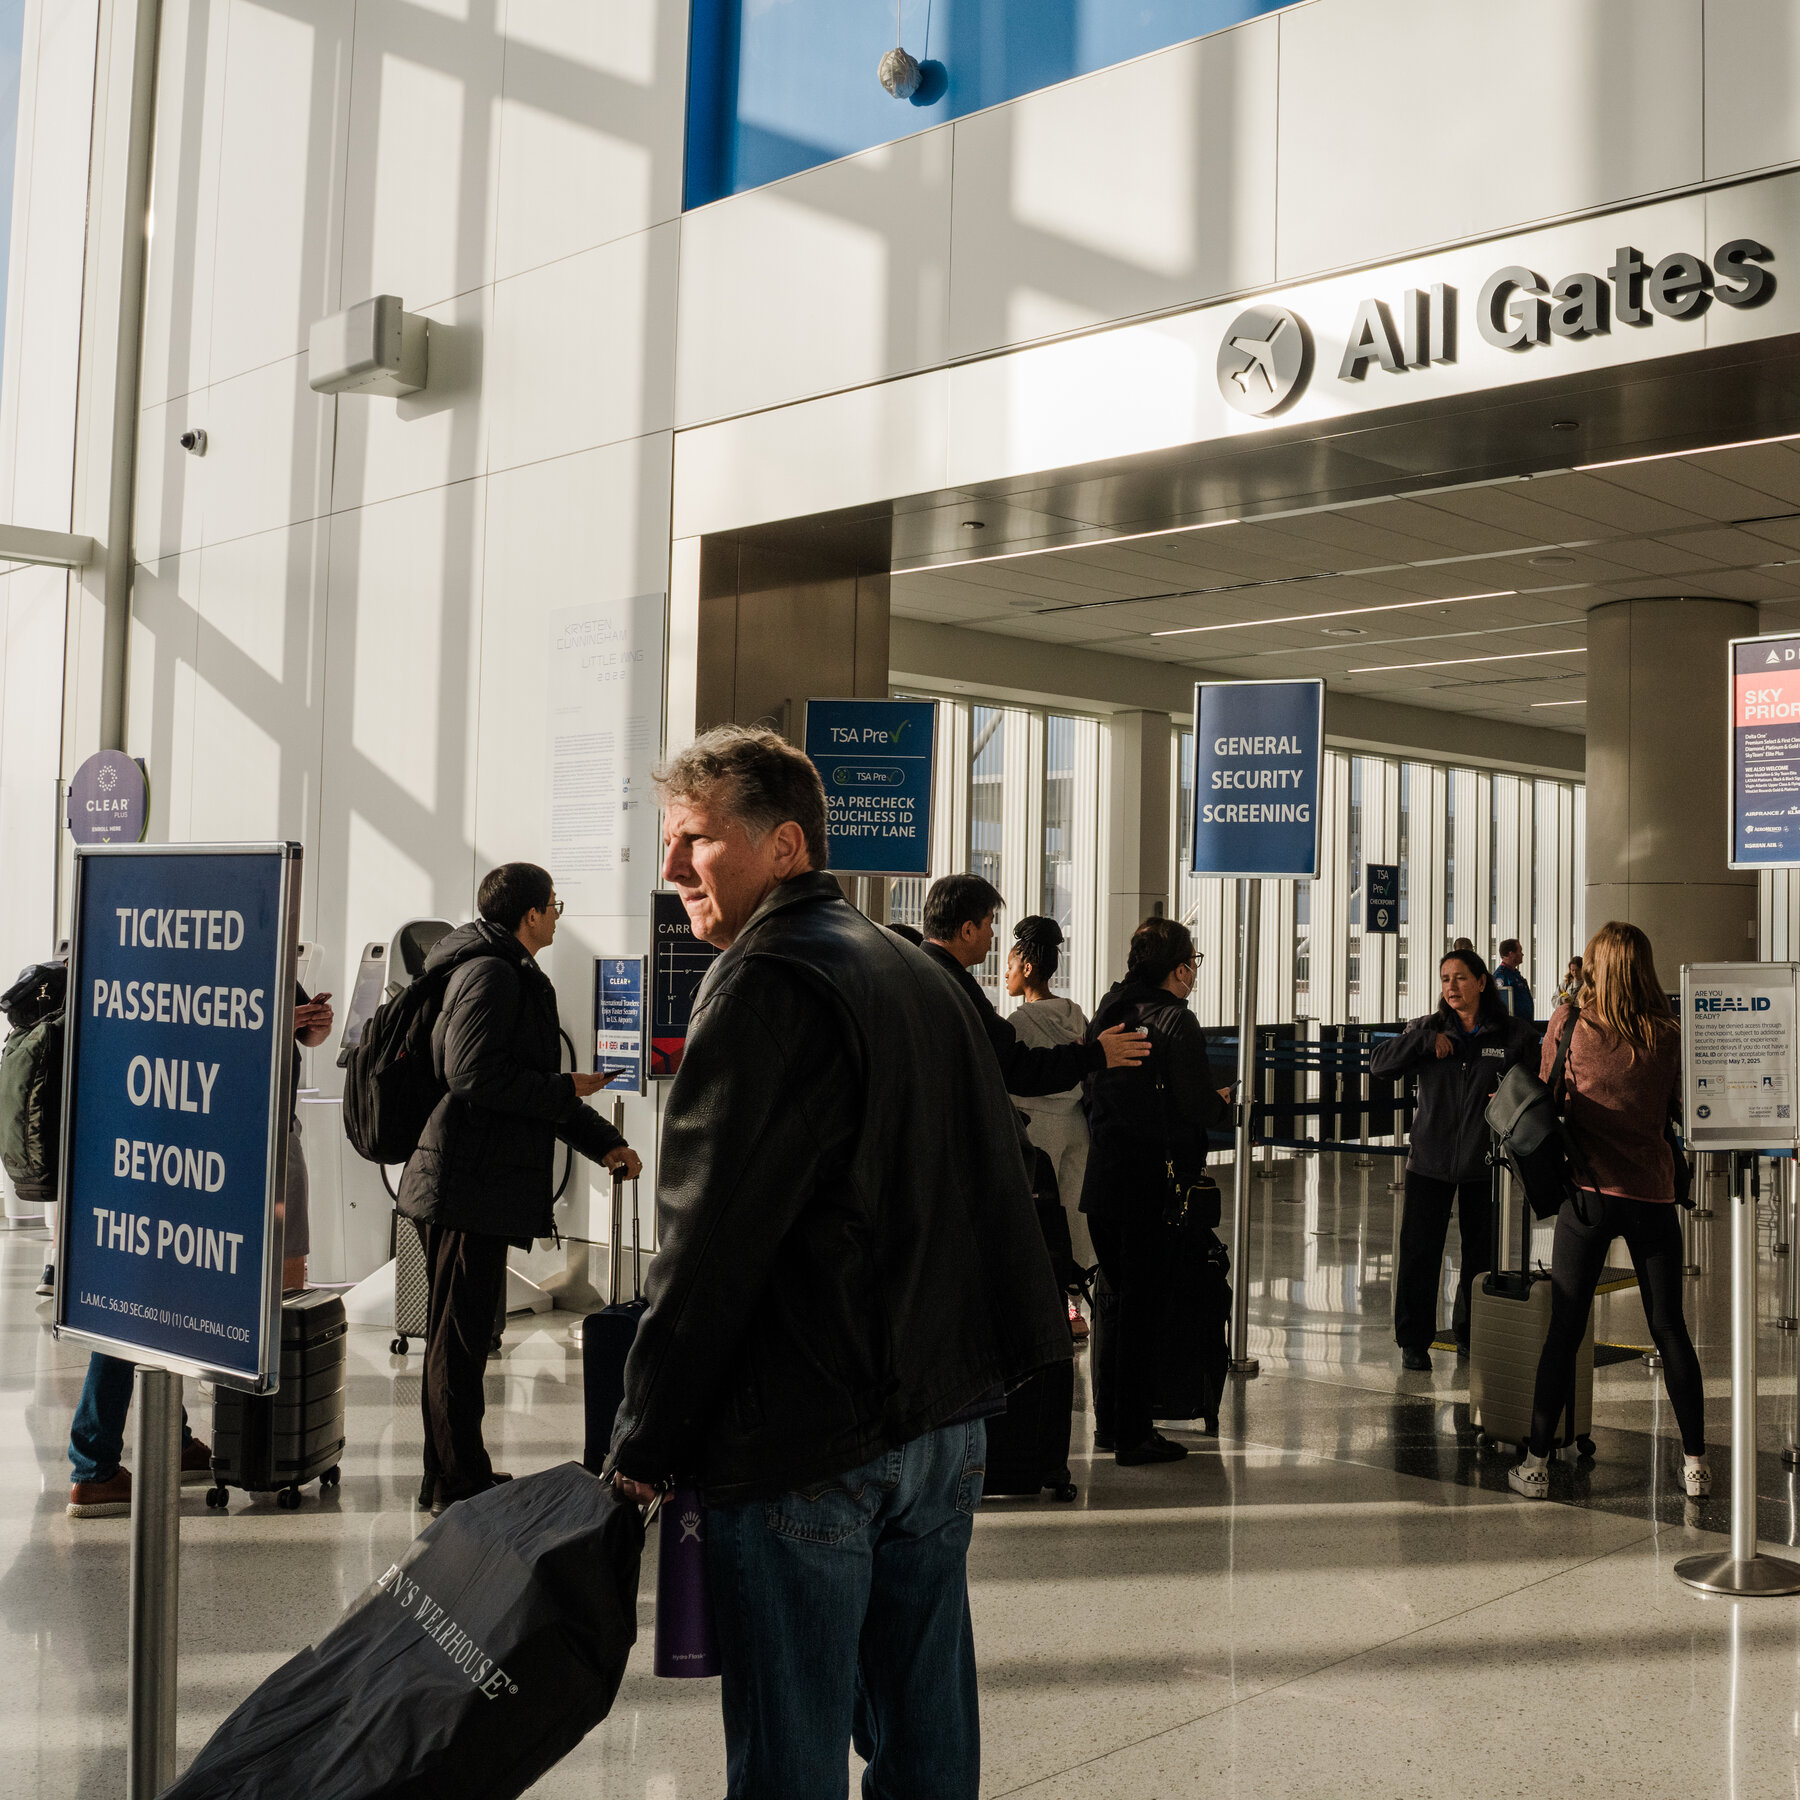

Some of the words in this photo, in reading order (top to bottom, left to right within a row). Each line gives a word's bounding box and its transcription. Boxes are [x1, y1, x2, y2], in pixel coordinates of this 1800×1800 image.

[1338, 281, 1458, 383] All
[1476, 238, 1774, 351] Gates
[564, 616, 614, 635] KRYSTEN
[1785, 648, 1800, 660] D
[1745, 688, 1782, 704] SKY
[830, 728, 859, 742] TSA
[863, 728, 888, 743] Pre
[1214, 736, 1302, 756] GENERAL
[857, 772, 871, 781] TSA
[873, 772, 886, 781] Pre
[1211, 770, 1303, 789] SECURITY
[86, 799, 128, 812] CLEAR
[849, 797, 915, 809] PRECHECK
[899, 812, 913, 823] ID
[1203, 804, 1310, 823] SCREENING
[826, 824, 879, 836] ECURITY
[883, 826, 916, 837] LANE
[1377, 870, 1389, 880] TSA
[1373, 884, 1384, 894] Pre
[116, 908, 244, 952] TICKETED
[658, 924, 690, 934] CARR
[93, 978, 264, 1031] PASSENGERS
[1695, 998, 1749, 1012] REAL
[1751, 997, 1770, 1011] ID
[126, 1054, 220, 1114] ONLY
[114, 1137, 226, 1192] BEYOND
[93, 1206, 150, 1260] THIS
[157, 1222, 244, 1274] POINT
[109, 1298, 128, 1314] 56.30
[172, 1312, 182, 1328] (1)
[227, 1326, 250, 1343] CODE
[377, 1563, 420, 1607] EN'S
